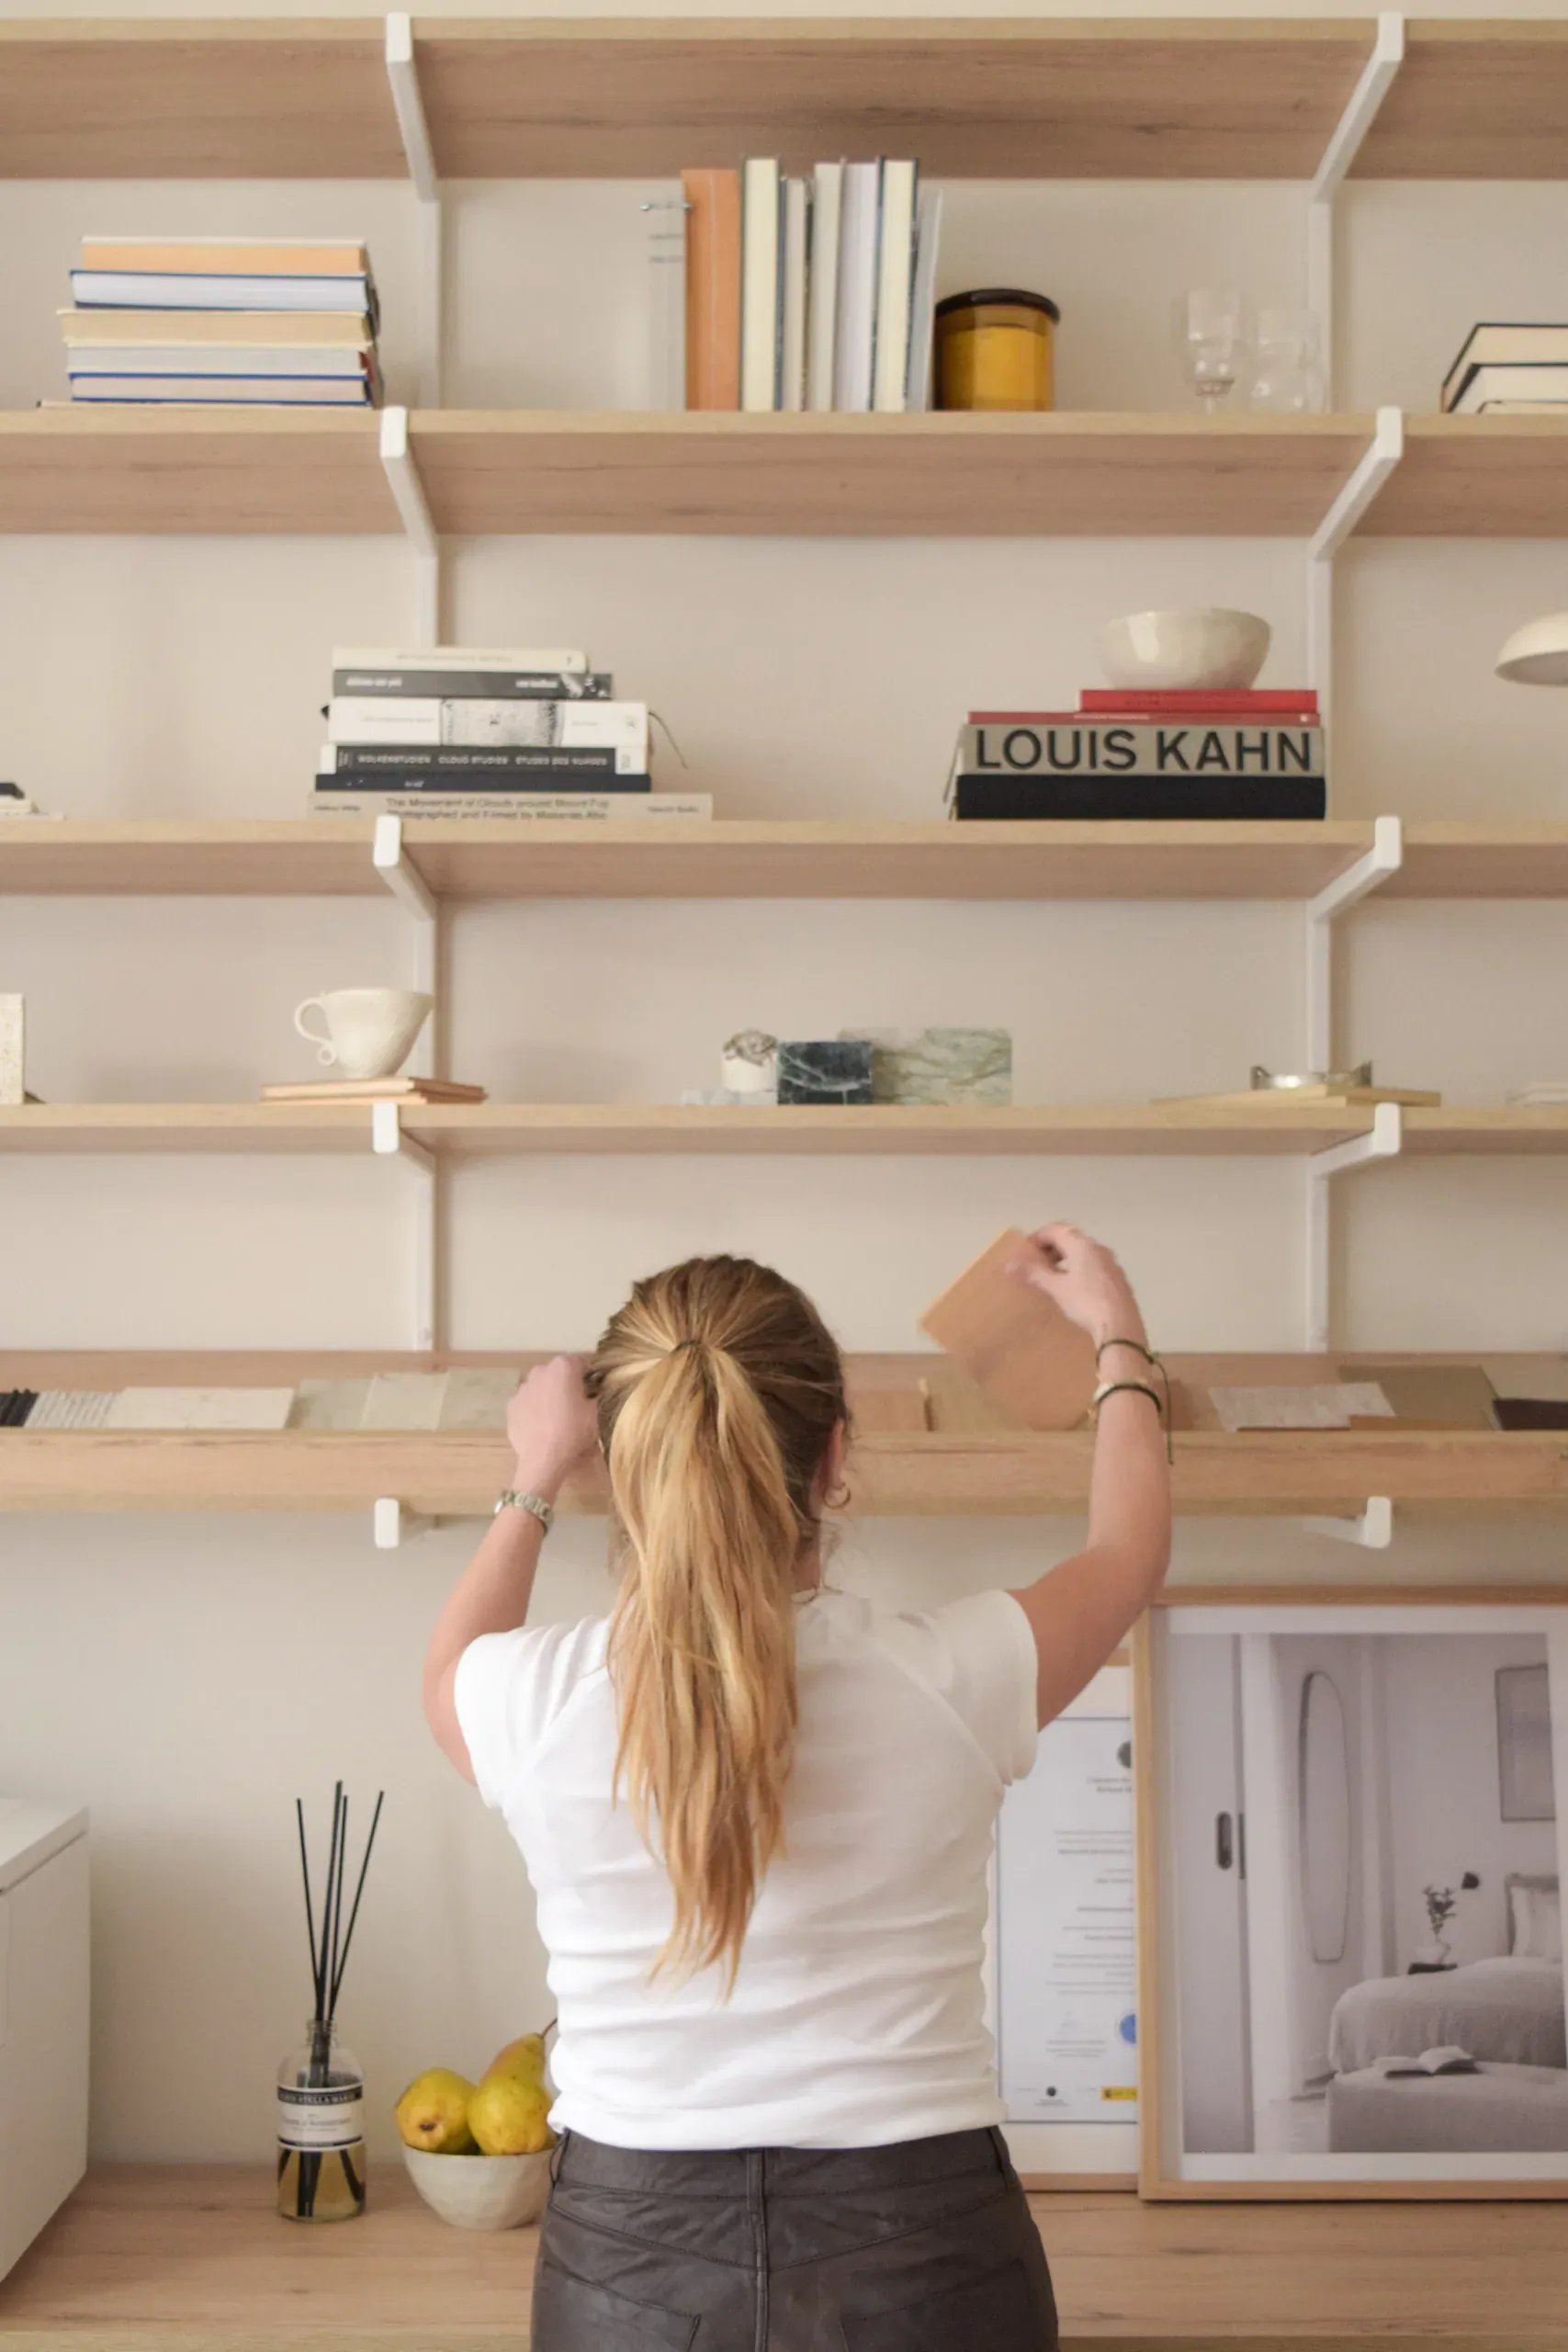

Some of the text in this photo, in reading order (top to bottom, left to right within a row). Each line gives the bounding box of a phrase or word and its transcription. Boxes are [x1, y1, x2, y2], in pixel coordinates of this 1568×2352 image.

[976, 729, 1311, 772] LOUIS KAHN
[386, 797, 406, 807] The
